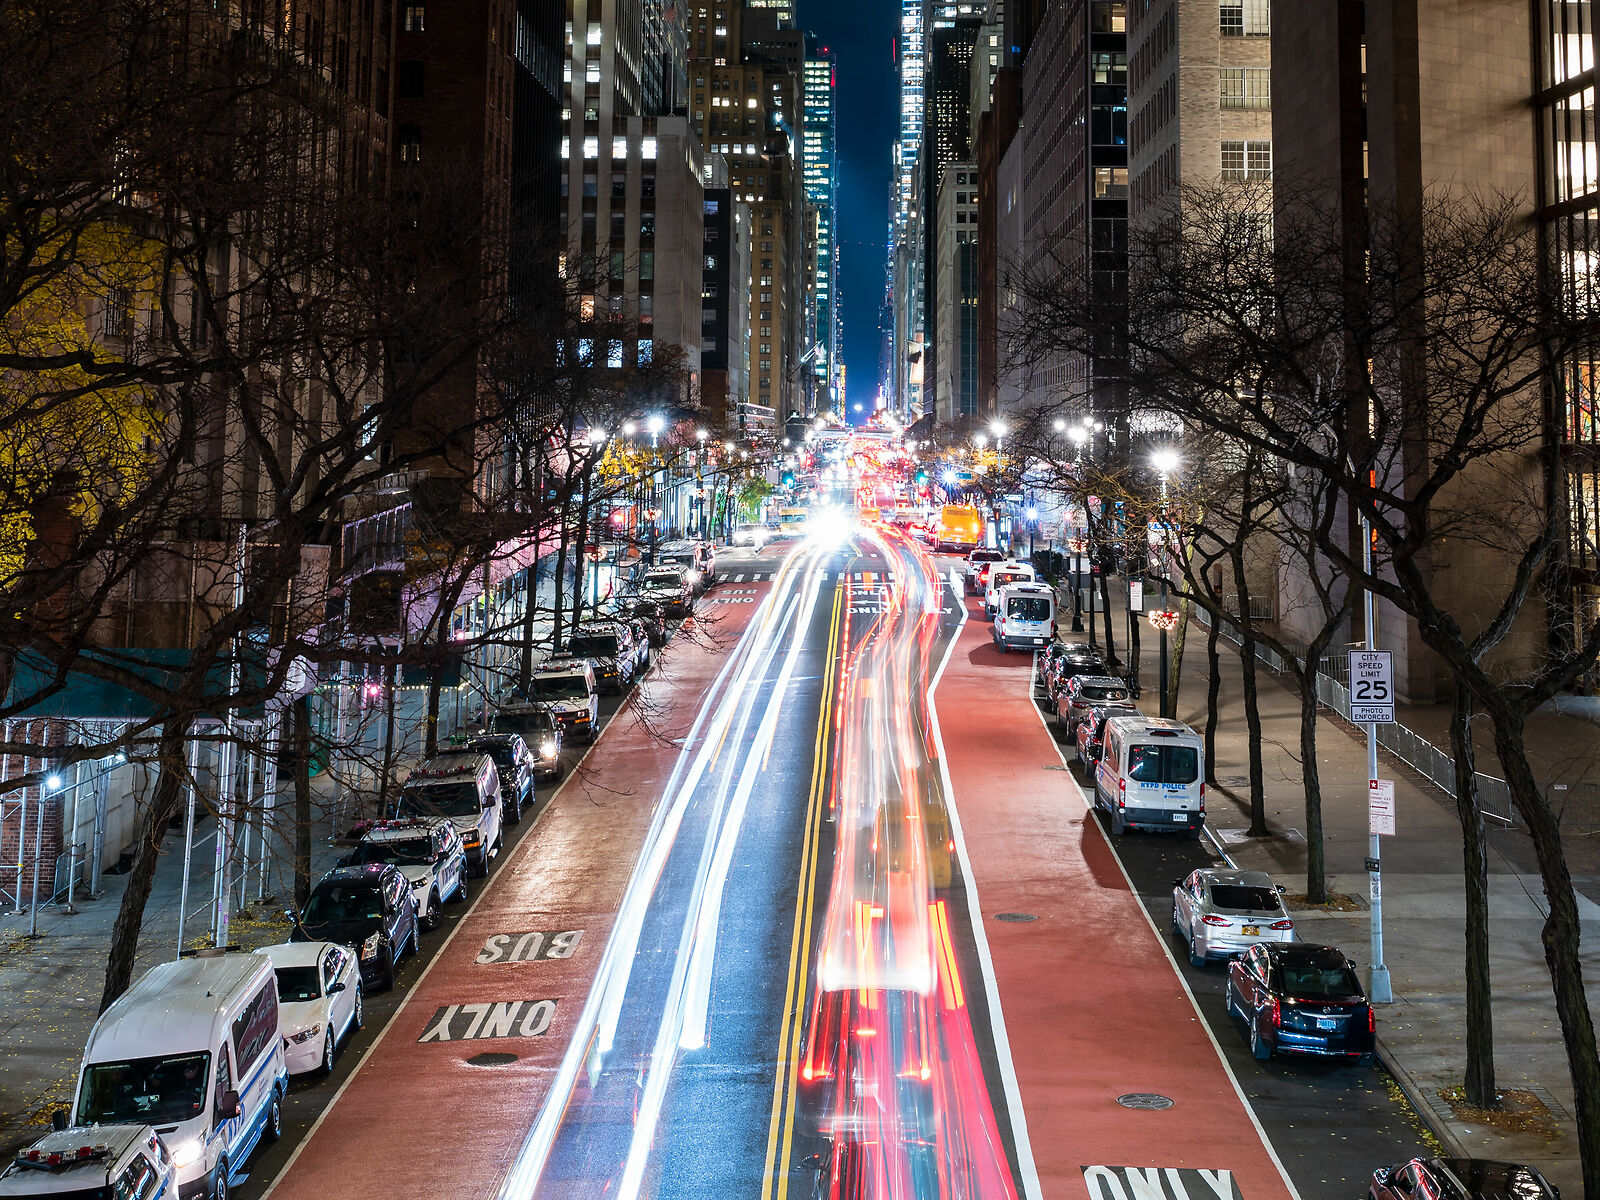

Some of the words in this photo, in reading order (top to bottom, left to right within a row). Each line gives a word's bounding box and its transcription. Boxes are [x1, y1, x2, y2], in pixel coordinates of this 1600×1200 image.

[1356, 680, 1388, 700] 25
[1162, 782, 1187, 790] POLICE
[476, 929, 585, 964] BUS
[418, 999, 556, 1043] ONLY
